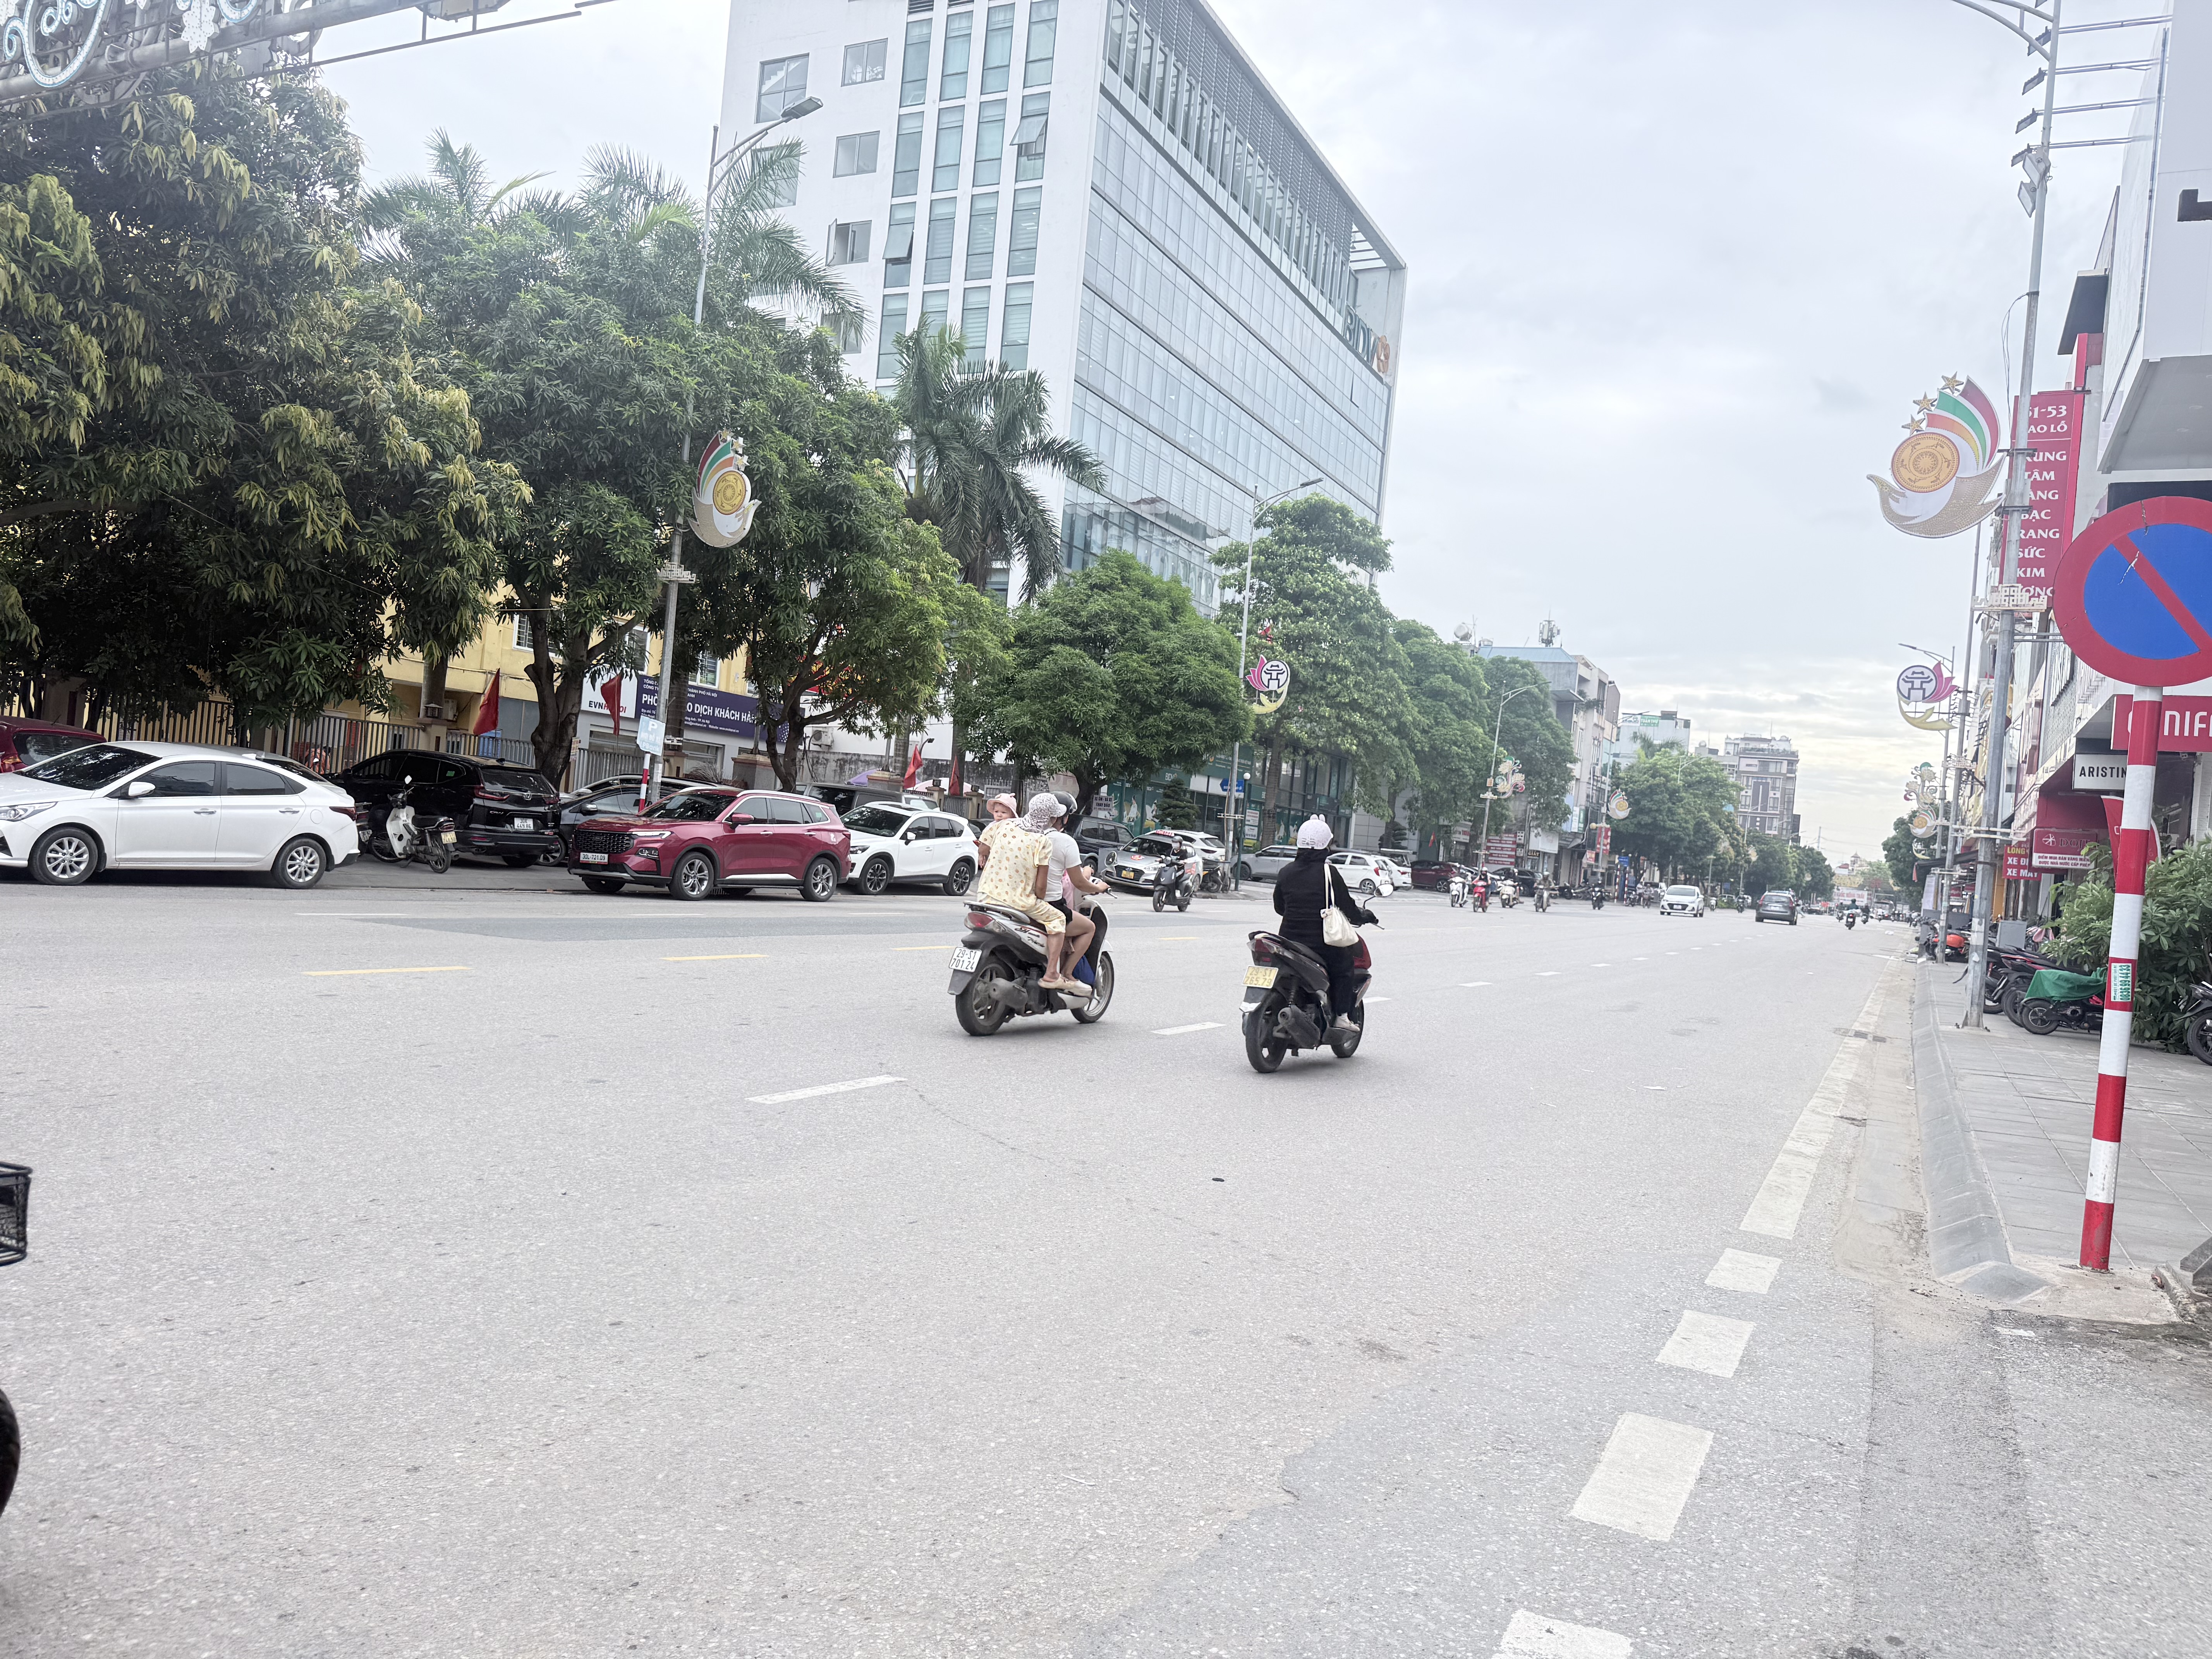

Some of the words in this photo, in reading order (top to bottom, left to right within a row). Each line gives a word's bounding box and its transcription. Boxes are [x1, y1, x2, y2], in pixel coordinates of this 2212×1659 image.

[2029, 405, 2067, 418] 1-53
[2028, 424, 2047, 433] AO
[2050, 421, 2068, 433] LỖ
[2026, 451, 2067, 462] UNG
[2029, 489, 2059, 500] ÀNG
[2020, 529, 2059, 539] RANG
[2018, 546, 2046, 558] SỨC
[2016, 567, 2045, 577] KIM
[642, 693, 658, 706] PHÒ
[588, 701, 627, 713] EVNHOI
[687, 702, 693, 712] O
[694, 703, 713, 717] DỊCH
[714, 707, 740, 721] KHÁCH
[648, 721, 657, 731] P
[2128, 710, 2212, 737] NIF
[2007, 857, 2018, 865] XE
[957, 949, 977, 960] 29-S1
[951, 958, 975, 970] 701.24
